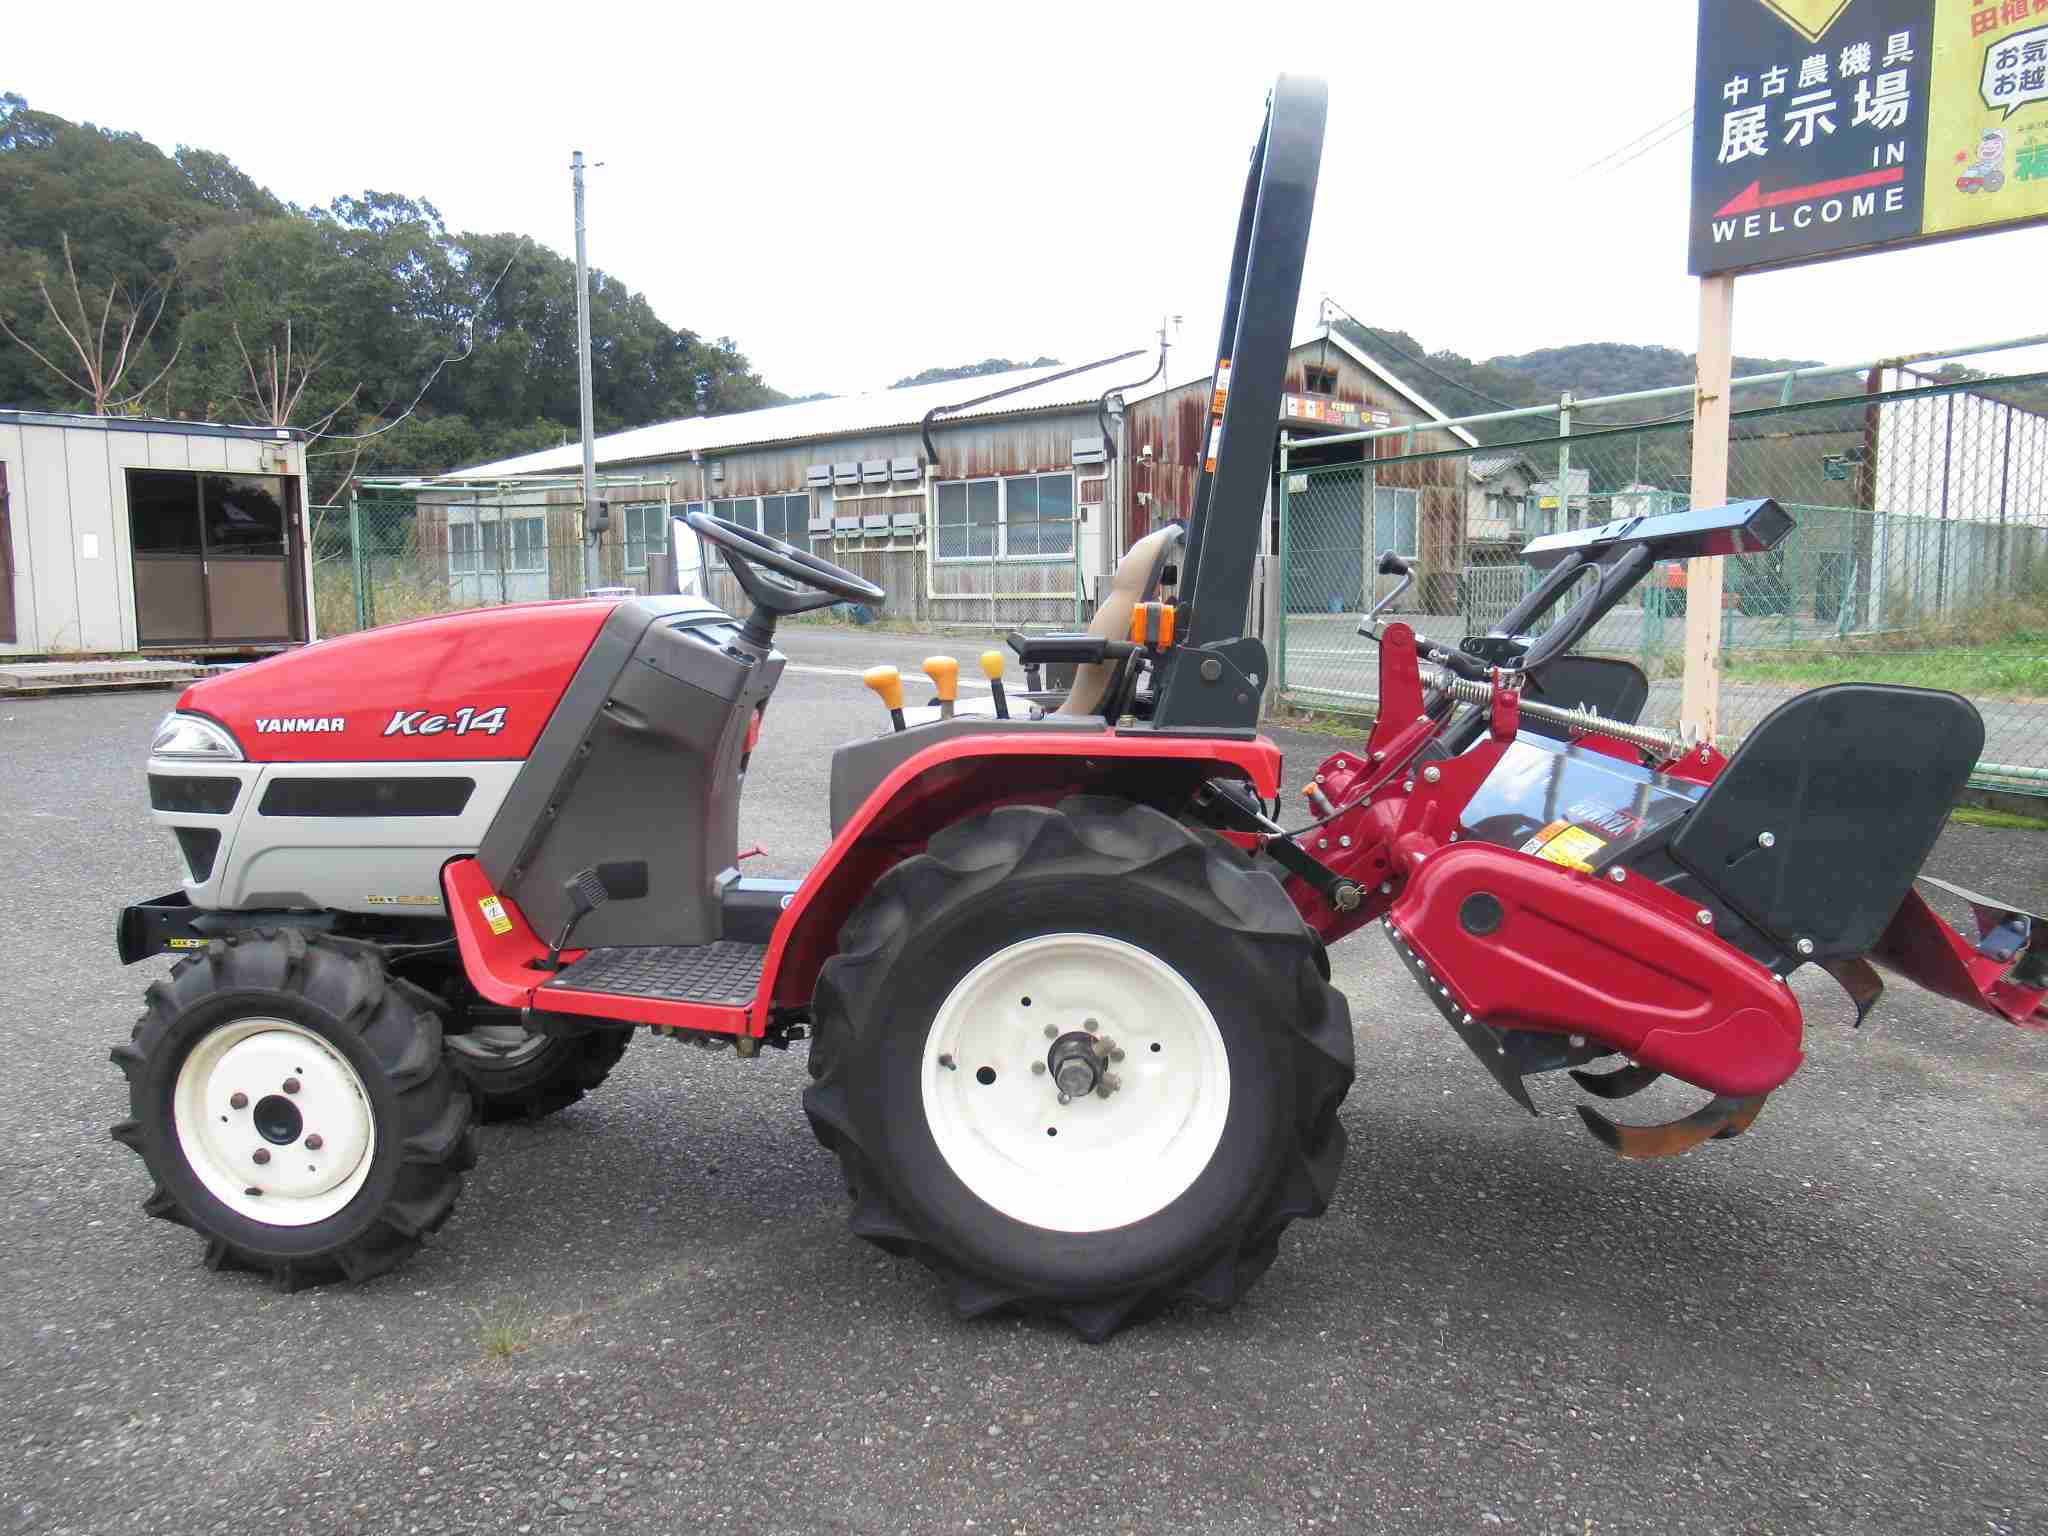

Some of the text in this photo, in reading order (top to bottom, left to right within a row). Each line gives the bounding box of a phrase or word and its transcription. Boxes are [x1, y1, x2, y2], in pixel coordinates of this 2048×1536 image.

[1722, 31, 1914, 105] 中古農機具
[1717, 69, 1911, 164] 展示場
[1872, 141, 1905, 168] IN
[1711, 187, 1904, 243] WELCOME
[255, 707, 508, 736] YANMAR Ke-14
